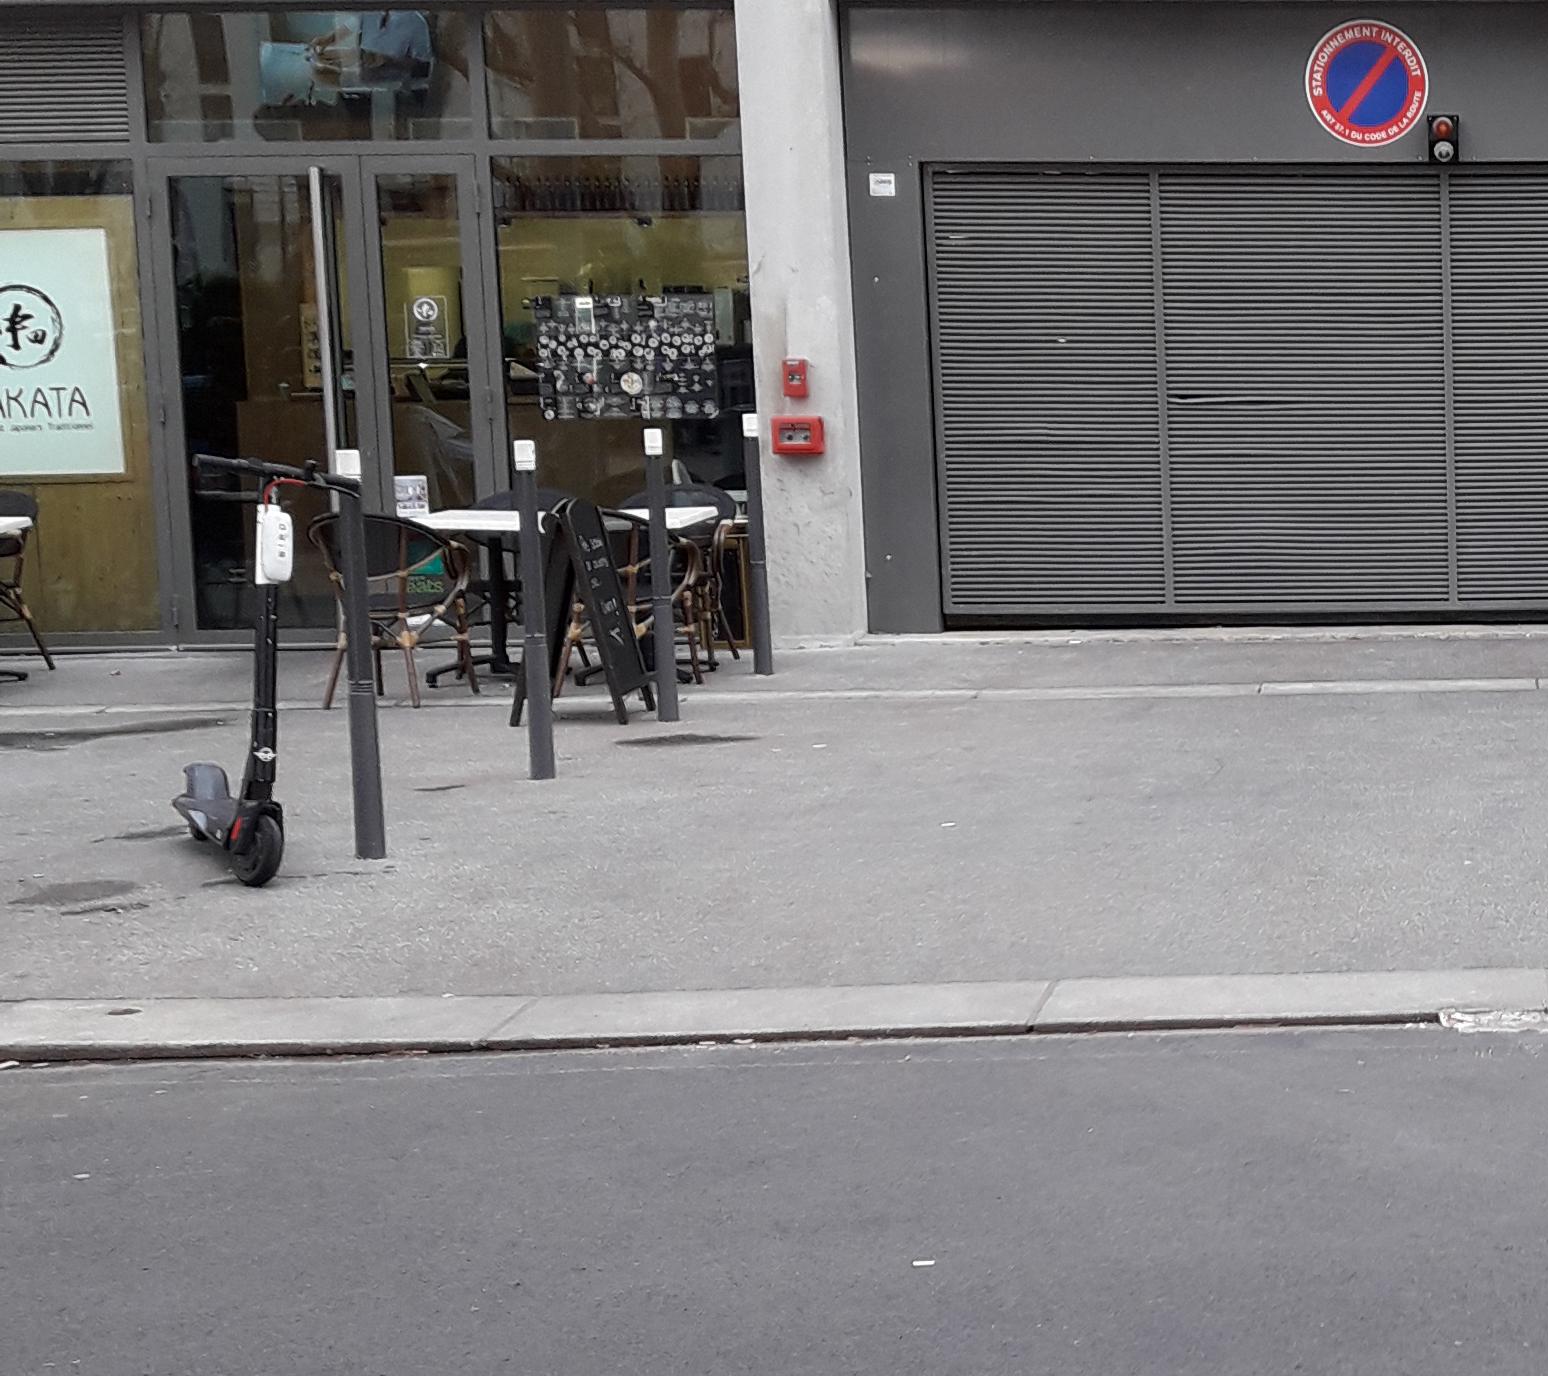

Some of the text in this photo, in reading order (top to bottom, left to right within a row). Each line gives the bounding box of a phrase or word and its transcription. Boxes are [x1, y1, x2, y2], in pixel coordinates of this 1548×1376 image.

[1312, 26, 1422, 97] STATIONNEMENT INTERDIT
[1321, 109, 1335, 125] ART
[1351, 130, 1363, 140] DU
[1364, 130, 1387, 141] CODE
[1387, 125, 1399, 136] DE
[1398, 117, 1410, 129] LA
[1406, 90, 1422, 119] ROUTE
